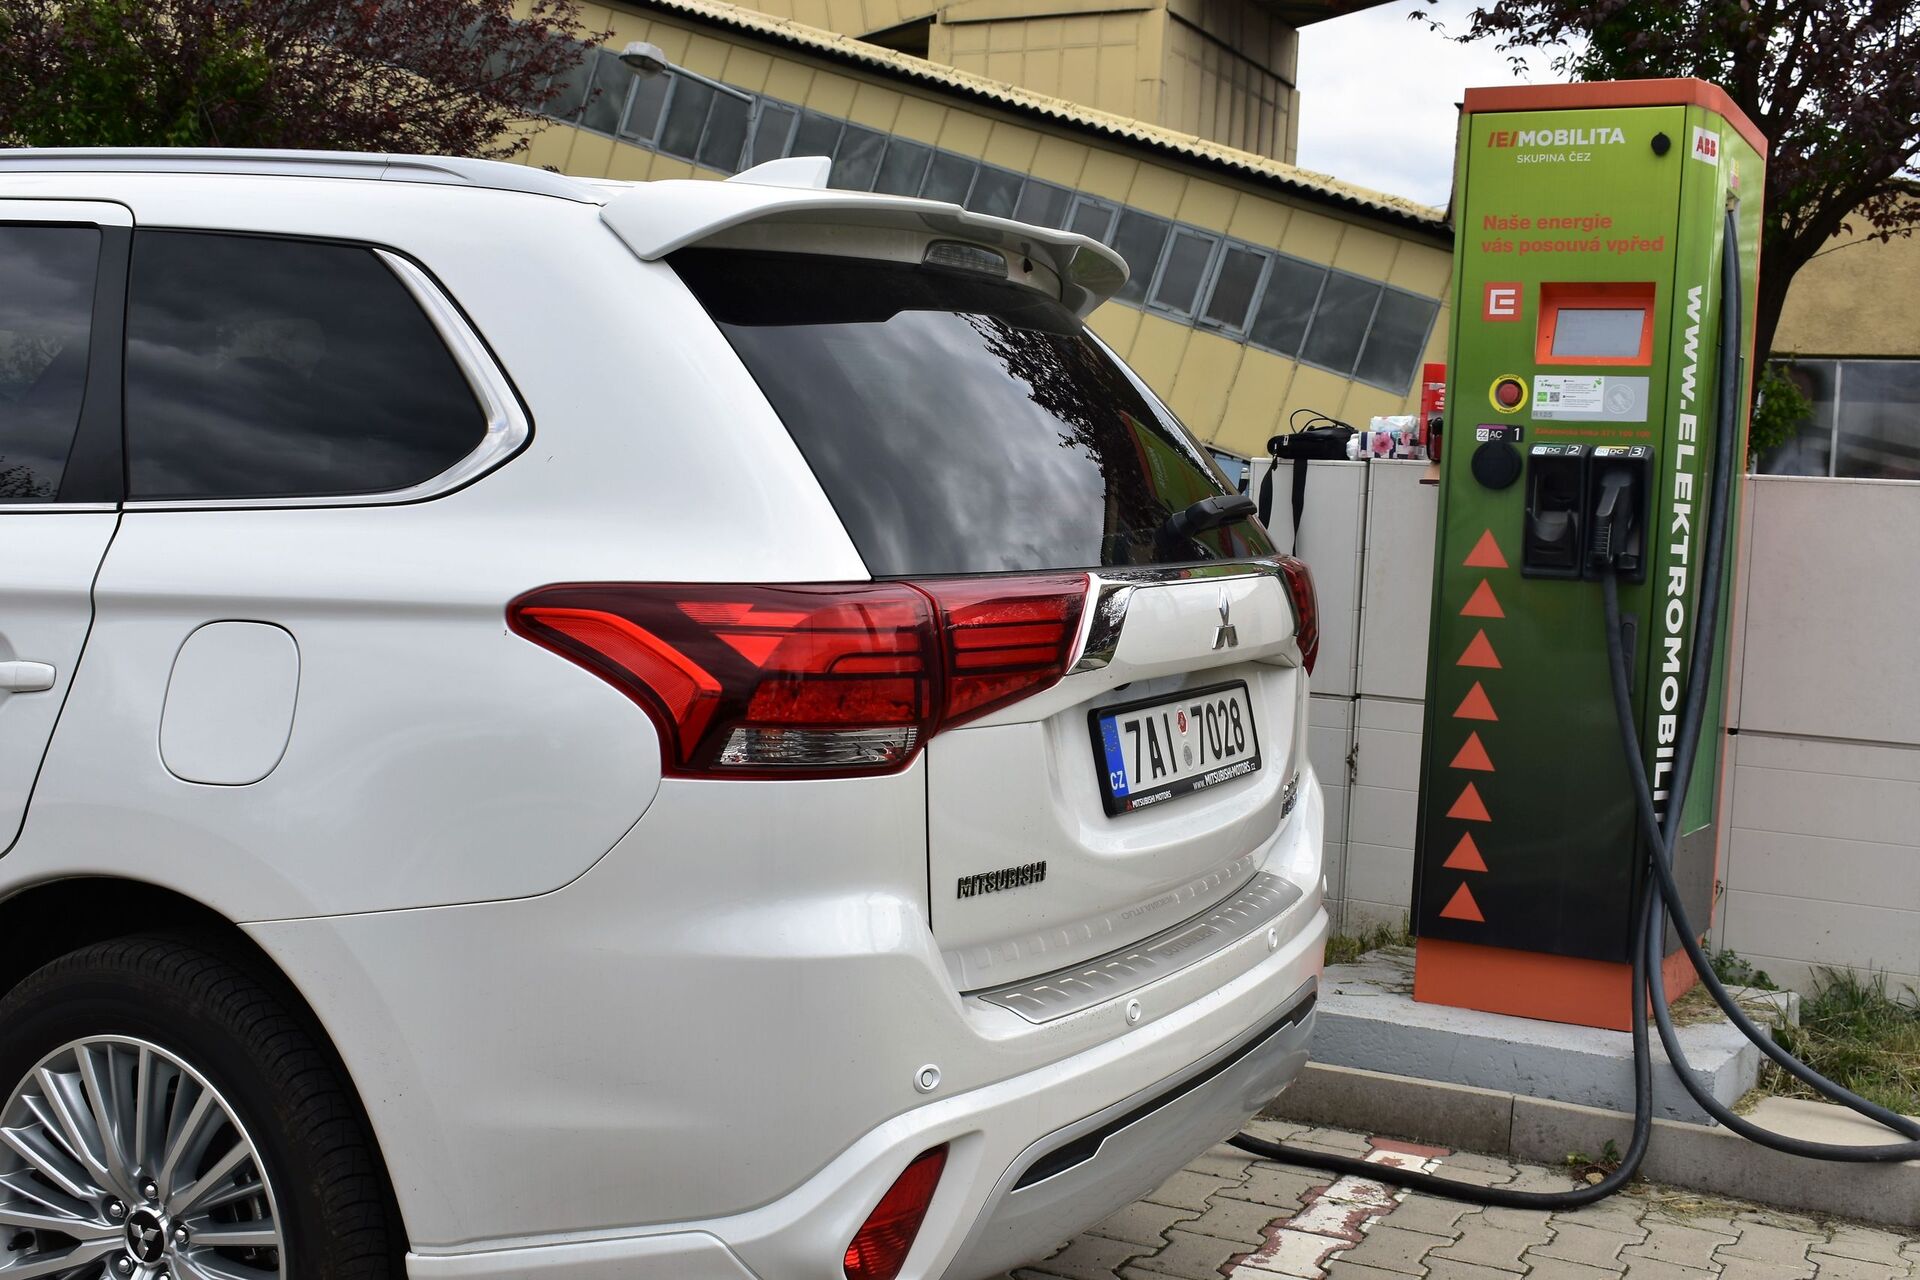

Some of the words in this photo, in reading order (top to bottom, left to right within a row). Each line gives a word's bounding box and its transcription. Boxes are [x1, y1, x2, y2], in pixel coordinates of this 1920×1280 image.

[1696, 135, 1716, 157] ABB
[1516, 153, 1566, 164] SKUPINA
[1568, 151, 1592, 162] ČEZ
[1483, 214, 1531, 231] Naše
[1537, 213, 1612, 232] energie
[1482, 237, 1514, 253] vás
[1519, 236, 1602, 256] posouvá
[1606, 235, 1665, 255] vpřed
[1477, 430, 1488, 438] 22
[1489, 430, 1503, 439] AC
[1514, 427, 1520, 441] 1
[1569, 446, 1579, 455] 2
[1631, 447, 1642, 456] 3
[1190, 697, 1245, 765] 7028
[1110, 770, 1126, 791] CZ
[1131, 794, 1156, 808] MITSUBISHI
[1155, 789, 1172, 803] MOTORS
